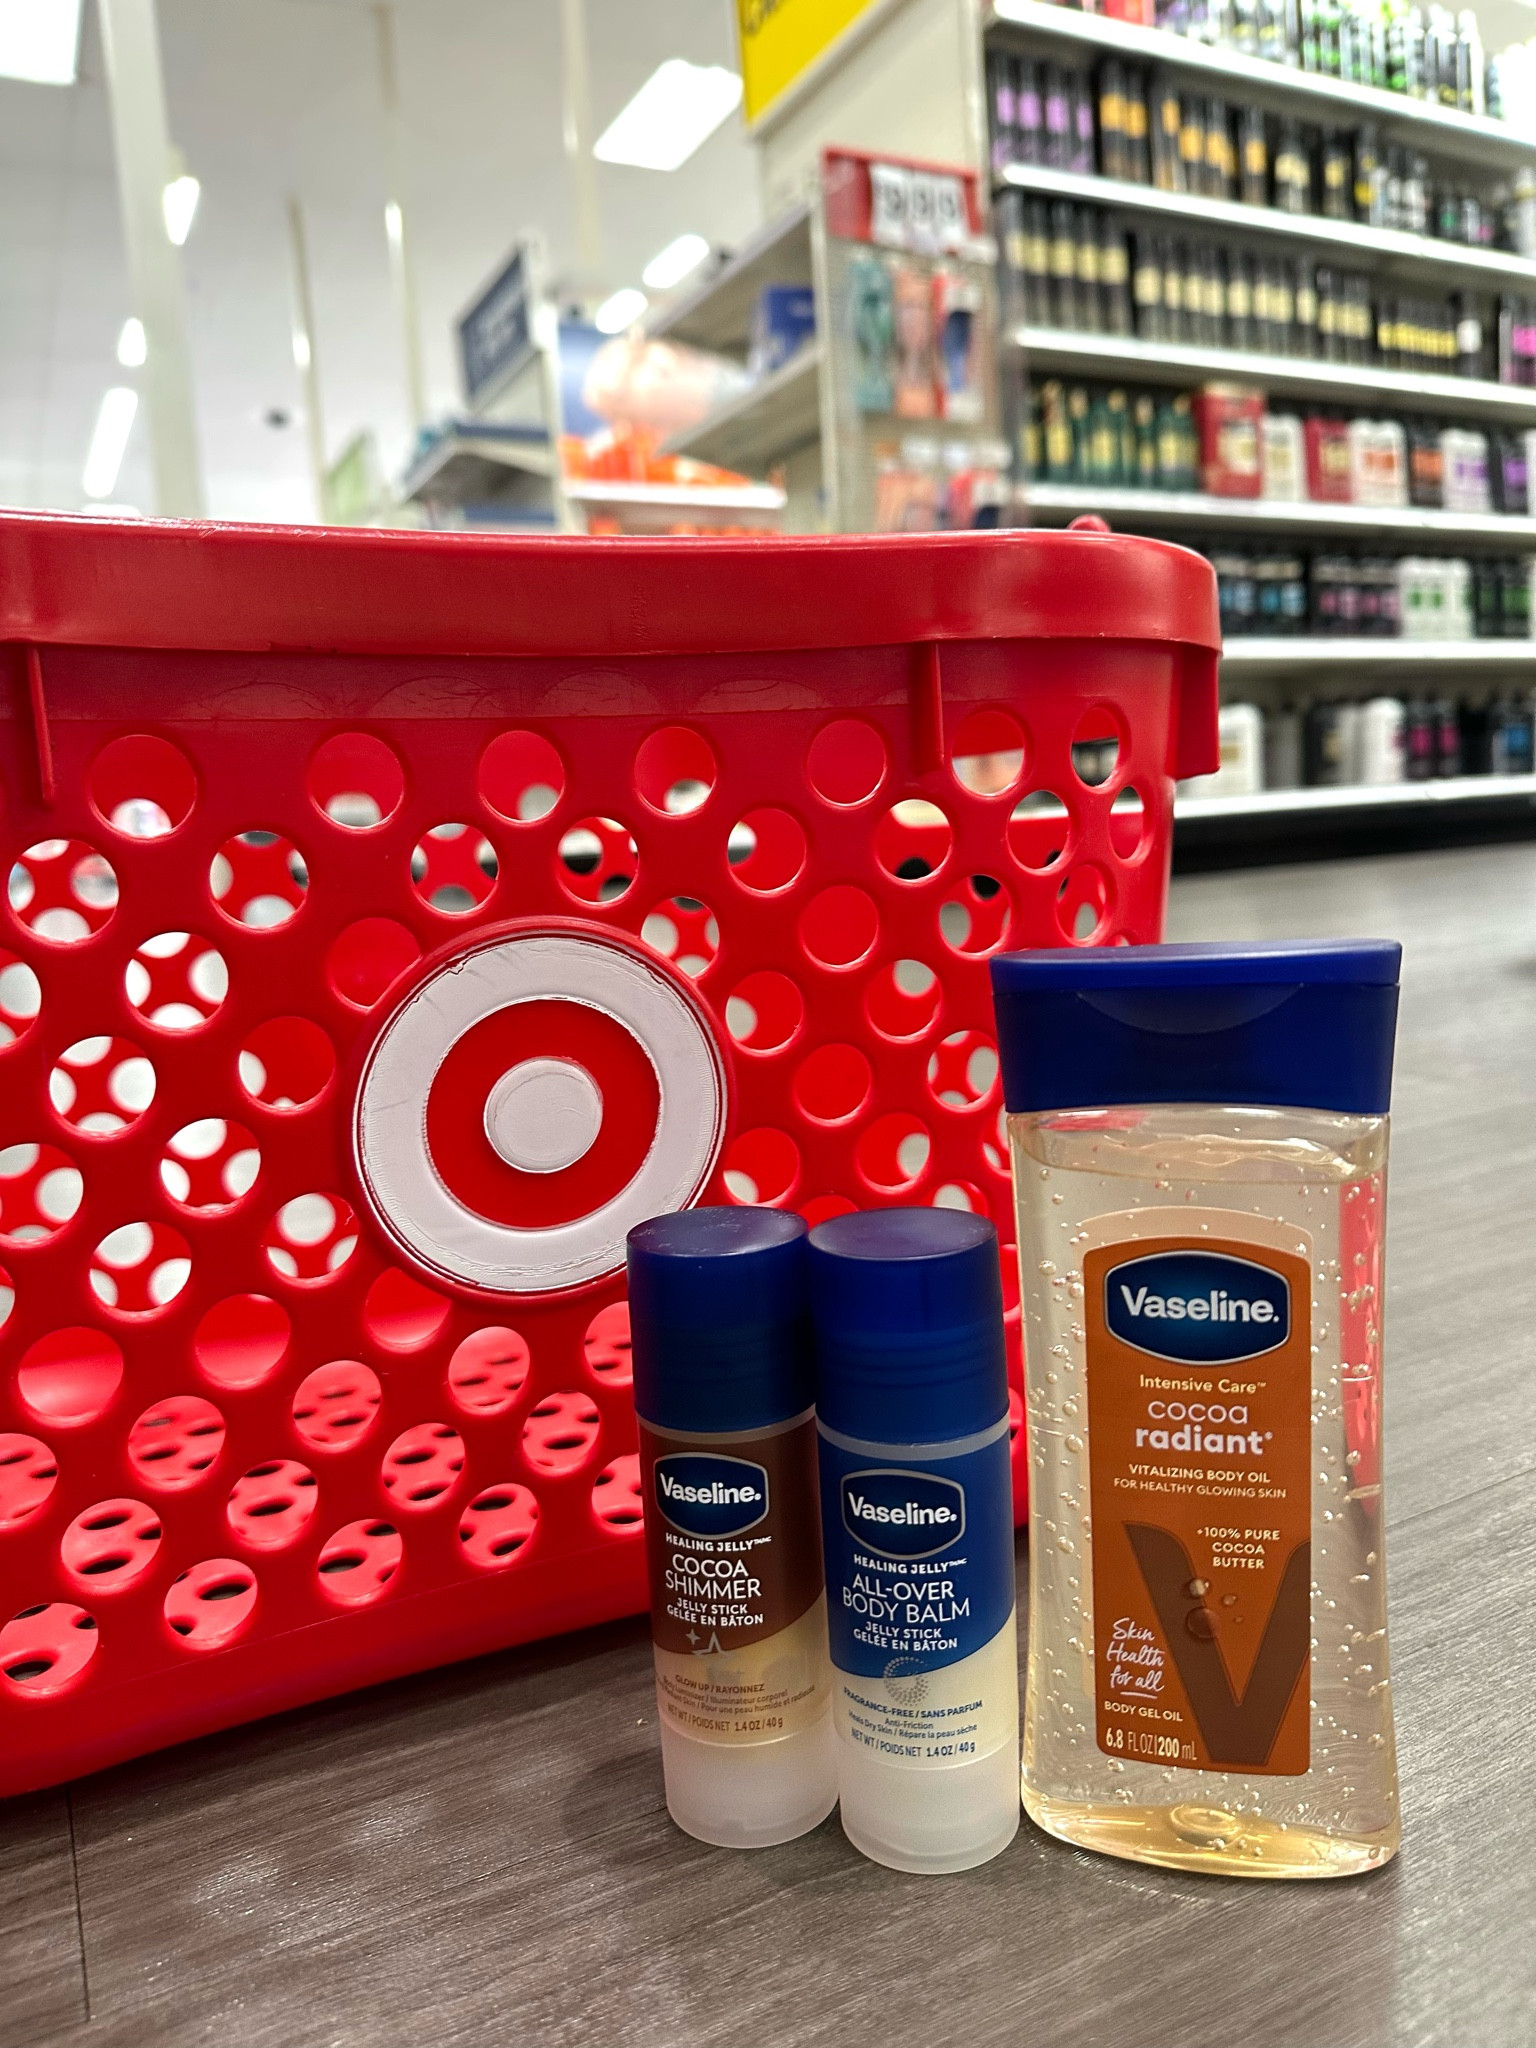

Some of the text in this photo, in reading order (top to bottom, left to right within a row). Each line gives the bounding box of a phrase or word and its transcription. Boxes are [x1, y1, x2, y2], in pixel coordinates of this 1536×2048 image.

[1139, 1374, 1213, 1393] Intensive
[1148, 1400, 1248, 1424] cocoa
[1128, 1464, 1271, 1483] VITALIZING BODY OIL
[1114, 1477, 1287, 1499] FOR HEALTHY GLOWING SKIN
[665, 1532, 714, 1552] HEALING
[1244, 1528, 1281, 1541] PURE
[1212, 1541, 1265, 1555] COCOA
[672, 1553, 749, 1578] COCOA
[853, 1554, 908, 1574] HEALING
[1212, 1556, 1265, 1570] BUTTER
[665, 1570, 762, 1600] SHIMMER
[852, 1573, 955, 1601] ALL-OVER
[666, 1604, 764, 1627] GELÉE EN BÂTON
[676, 1597, 748, 1615] JELLY STICK
[843, 1586, 970, 1624] BODY BALM
[853, 1628, 957, 1651] GELÉE EN BÂTON
[865, 1621, 942, 1639] JELLY STICK
[1112, 1617, 1155, 1642] Skin
[1106, 1641, 1165, 1667] Health
[675, 1674, 697, 1689] GLOW
[700, 1682, 710, 1691] UP
[715, 1683, 765, 1694] RAYONNEZ
[1110, 1665, 1165, 1692] for all
[843, 1687, 914, 1718] FRAGRANCE-FREE
[920, 1709, 946, 1718] SANS
[947, 1699, 983, 1716] PARFUM
[1104, 1700, 1184, 1722] BODY GEL OIL
[715, 1721, 730, 1731] NET
[734, 1721, 748, 1732] 1.4
[749, 1719, 761, 1731] OZ
[884, 1717, 933, 1730] Anti-Friction
[936, 1729, 955, 1740] peau
[1106, 1727, 1124, 1749] 6.8
[1128, 1731, 1139, 1752] FL
[905, 1745, 921, 1757] NET
[926, 1746, 940, 1758] 1.4
[941, 1744, 953, 1756] OZ
